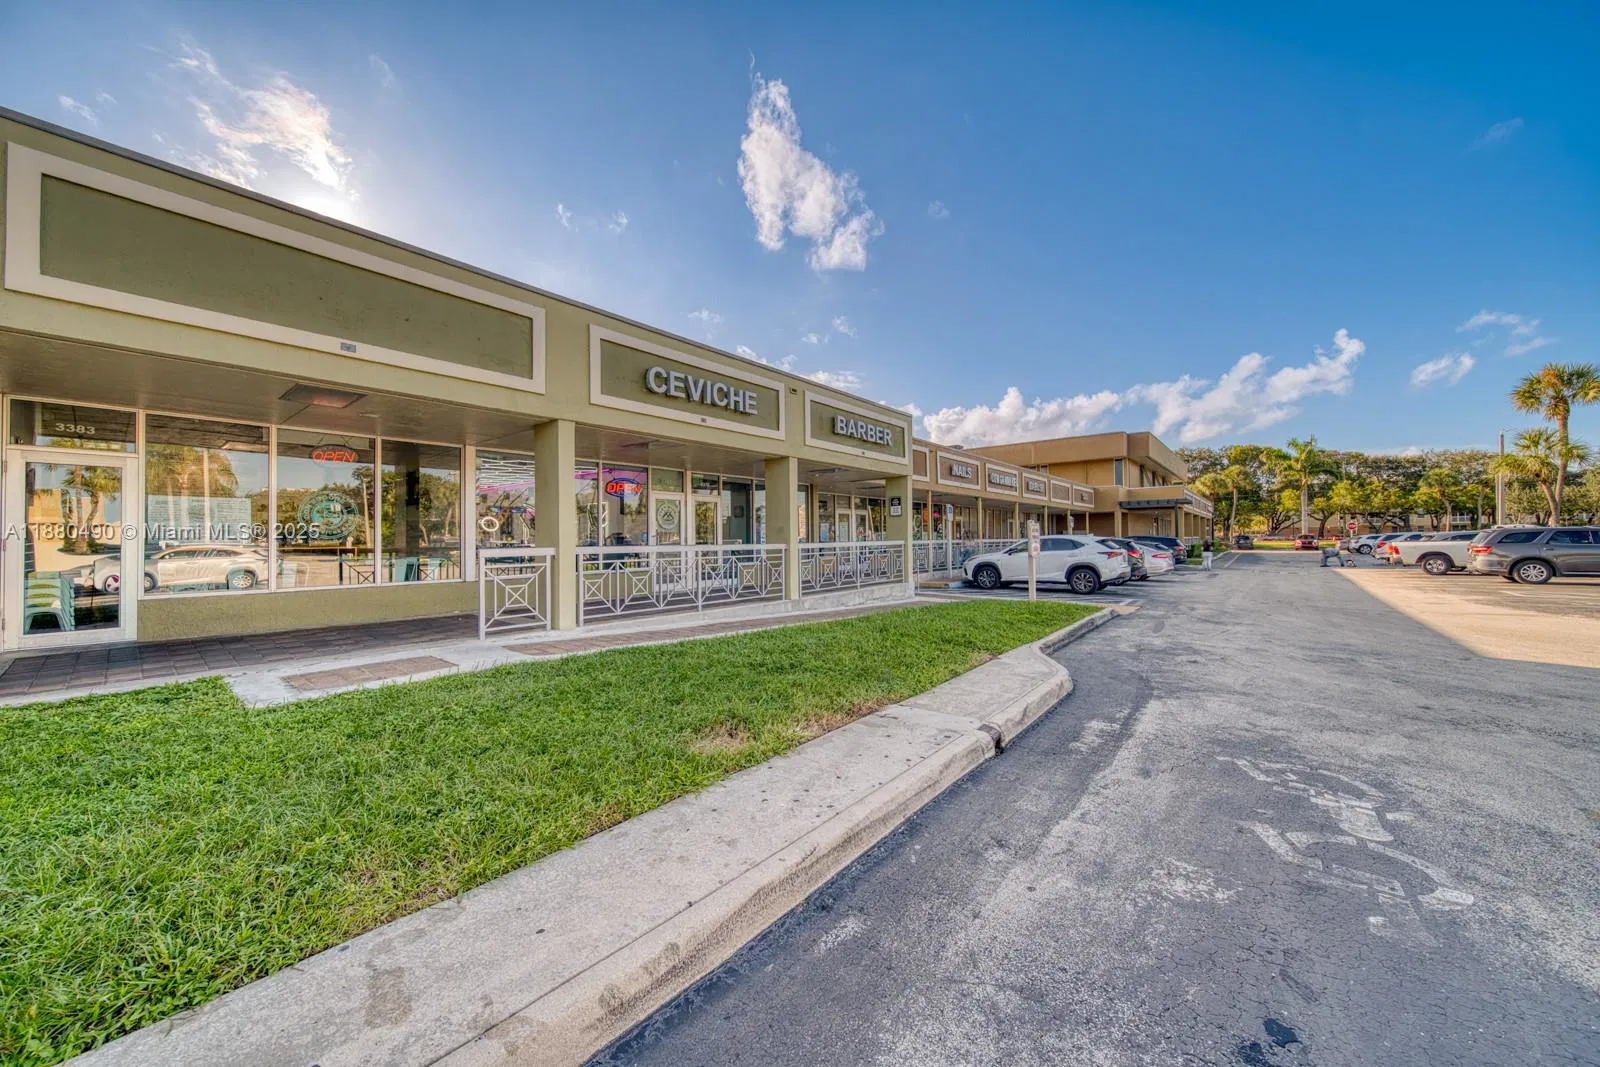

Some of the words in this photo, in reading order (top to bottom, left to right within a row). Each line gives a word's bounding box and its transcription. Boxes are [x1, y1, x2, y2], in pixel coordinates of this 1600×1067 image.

[646, 366, 758, 415] CEVICHE
[55, 422, 96, 435] 3383
[833, 415, 892, 447] BARBER
[311, 450, 357, 463] OPEN
[951, 464, 972, 479] NAILS
[606, 482, 641, 495] OPEN
